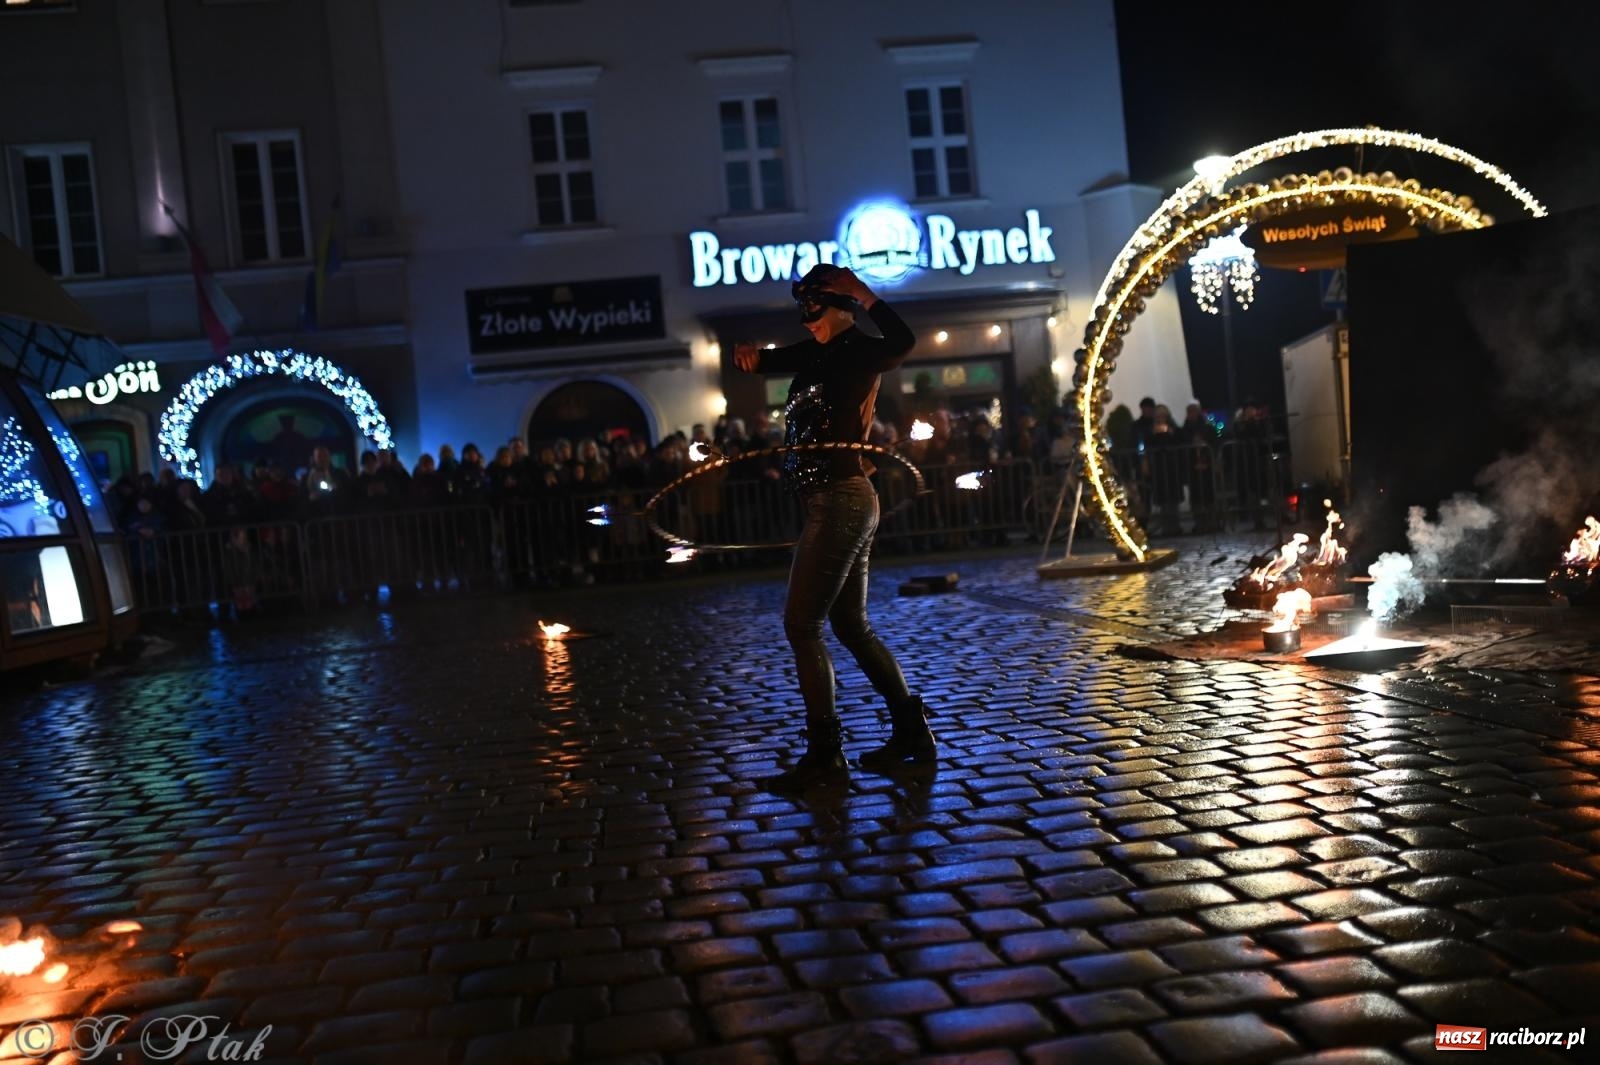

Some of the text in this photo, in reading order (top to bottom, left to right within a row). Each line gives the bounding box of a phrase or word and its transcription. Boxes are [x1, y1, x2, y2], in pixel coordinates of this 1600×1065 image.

[1343, 215, 1387, 232] Świąt
[690, 209, 1056, 287] Browar Rynek
[479, 299, 653, 338] Złote Wypieki
